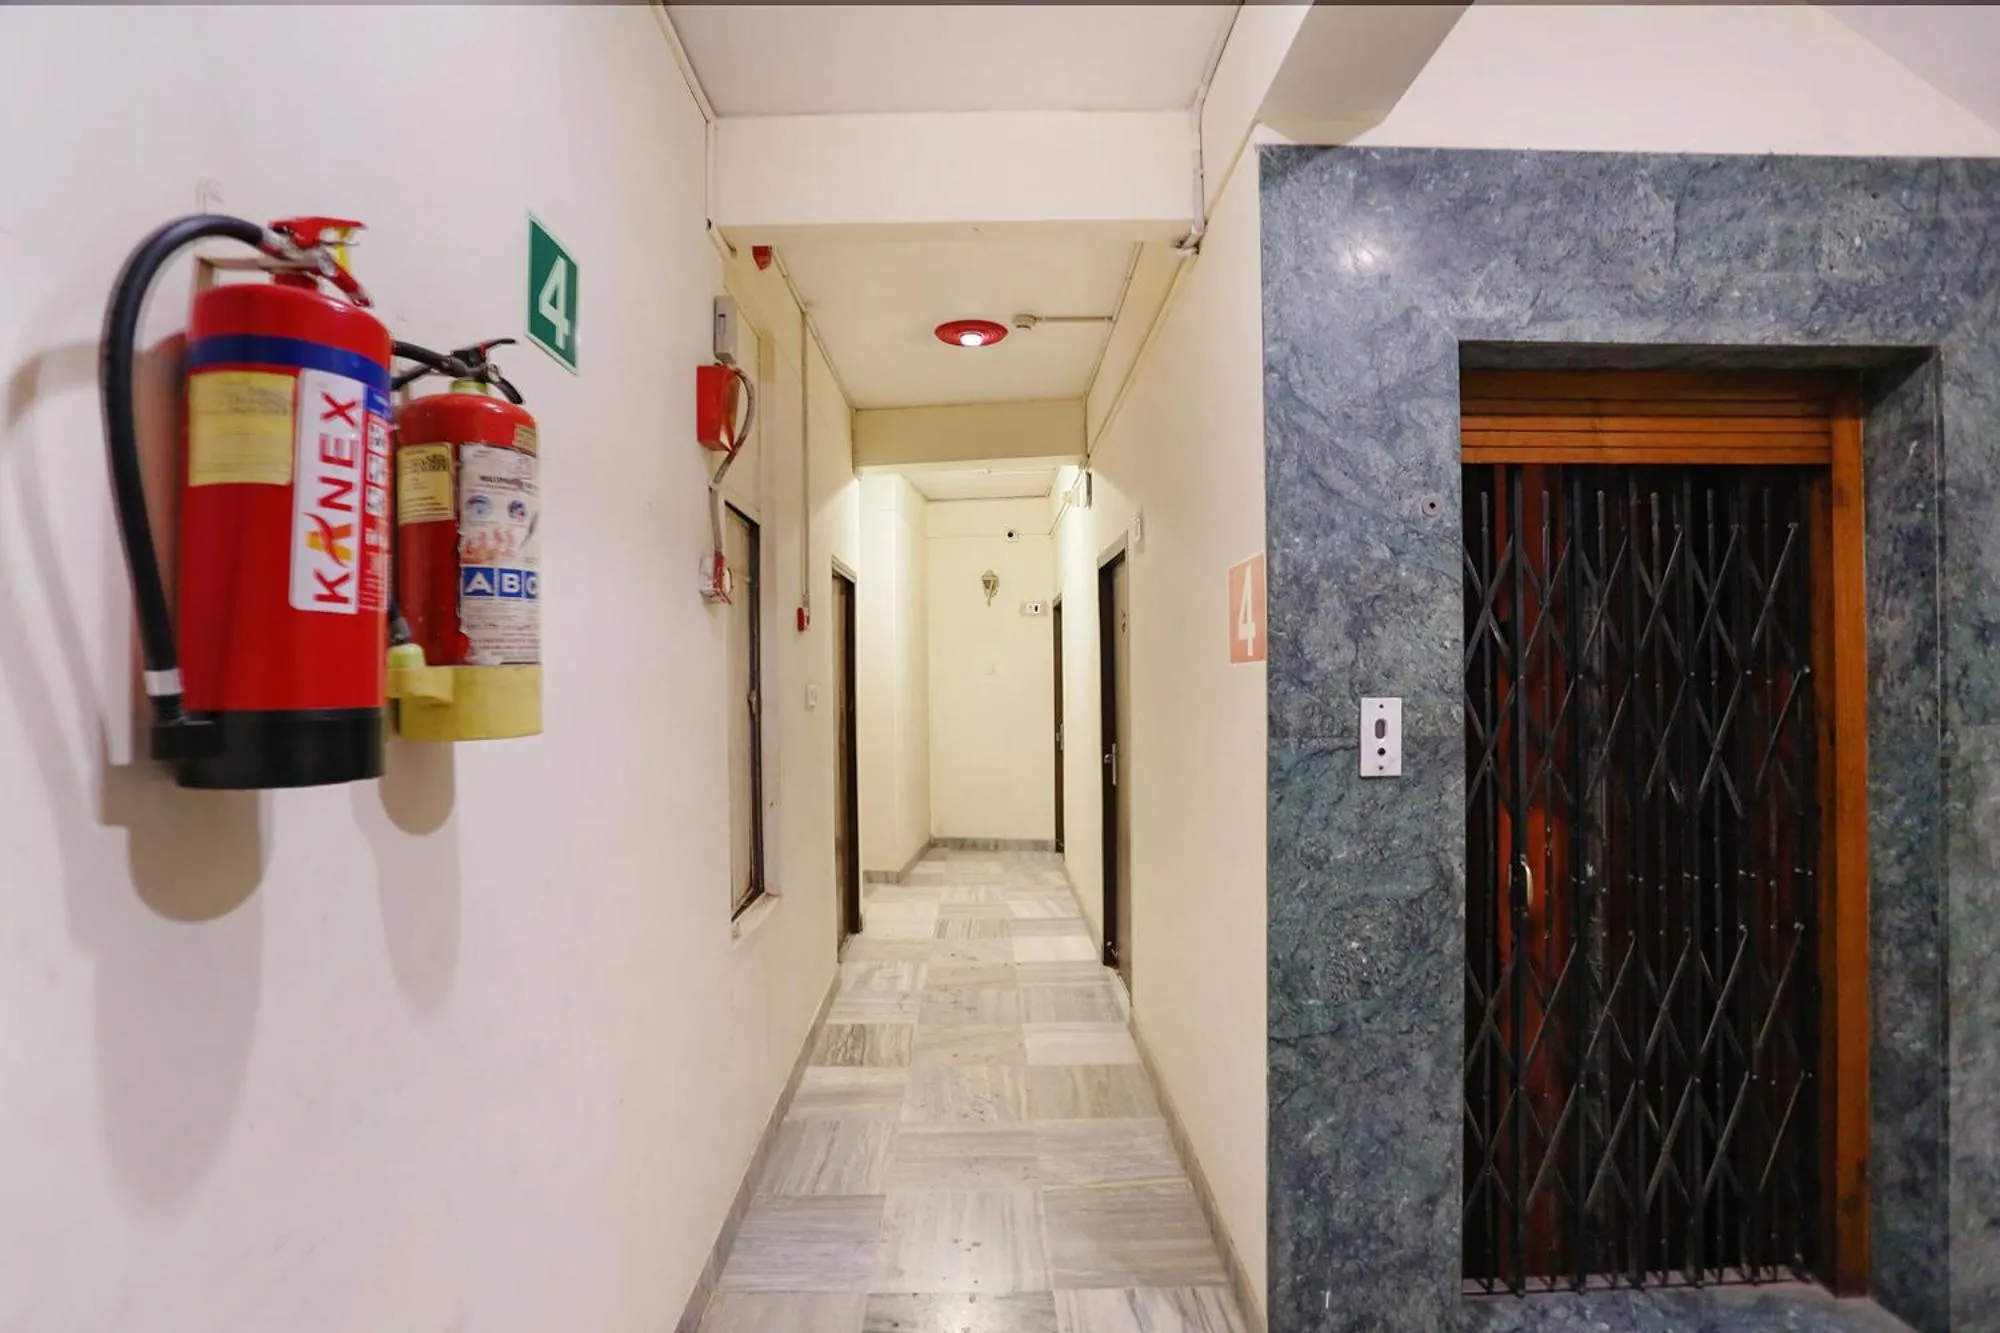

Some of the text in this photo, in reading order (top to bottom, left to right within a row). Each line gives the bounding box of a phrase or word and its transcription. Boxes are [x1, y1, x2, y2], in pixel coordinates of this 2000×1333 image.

[539, 255, 570, 349] 4
[305, 391, 358, 604] KANEX
[1238, 565, 1256, 656] 4
